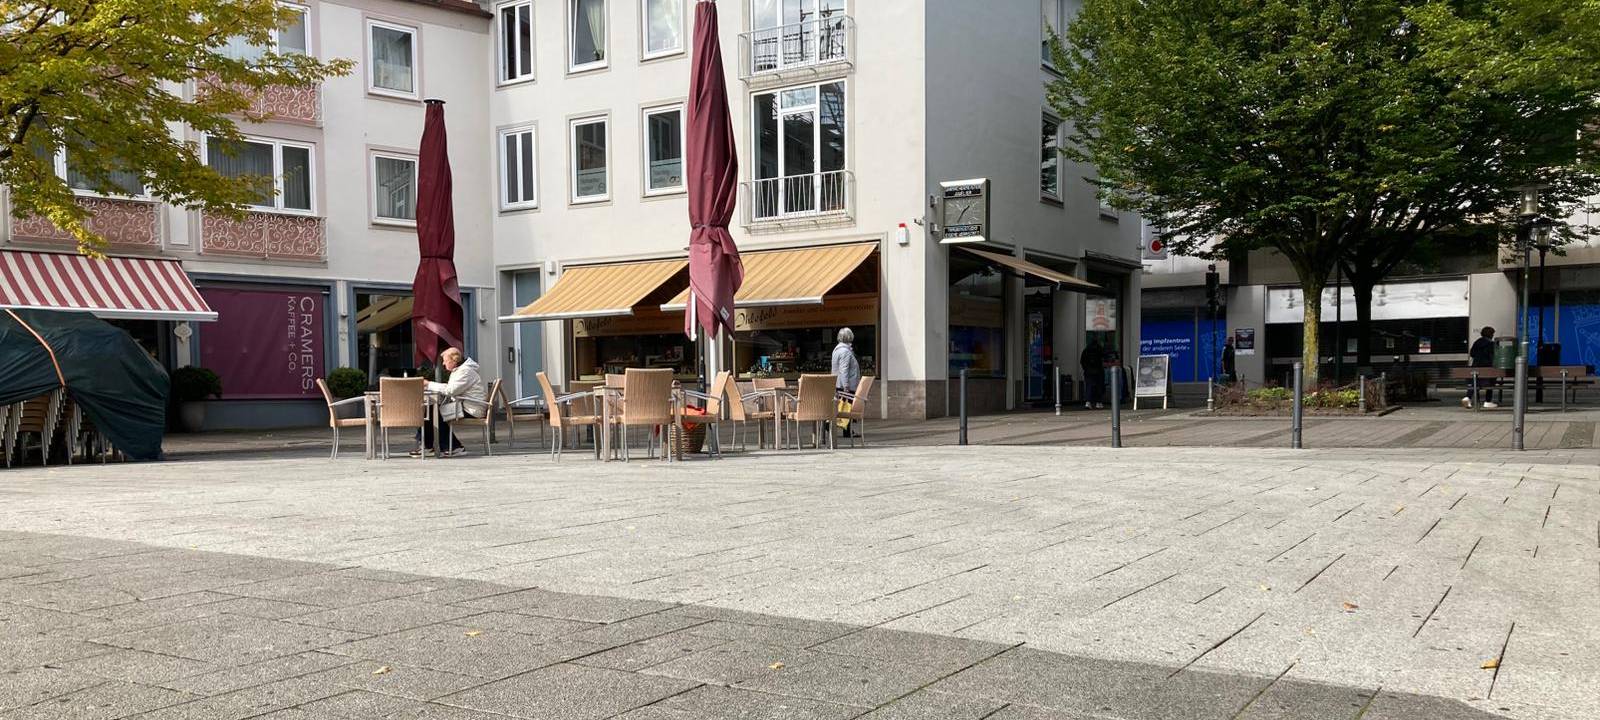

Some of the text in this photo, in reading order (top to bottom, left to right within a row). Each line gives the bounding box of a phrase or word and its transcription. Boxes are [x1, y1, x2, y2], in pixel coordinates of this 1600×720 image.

[287, 295, 297, 339] KAFFEE
[288, 352, 297, 374] CO.
[300, 296, 315, 394] CRAMERS.
